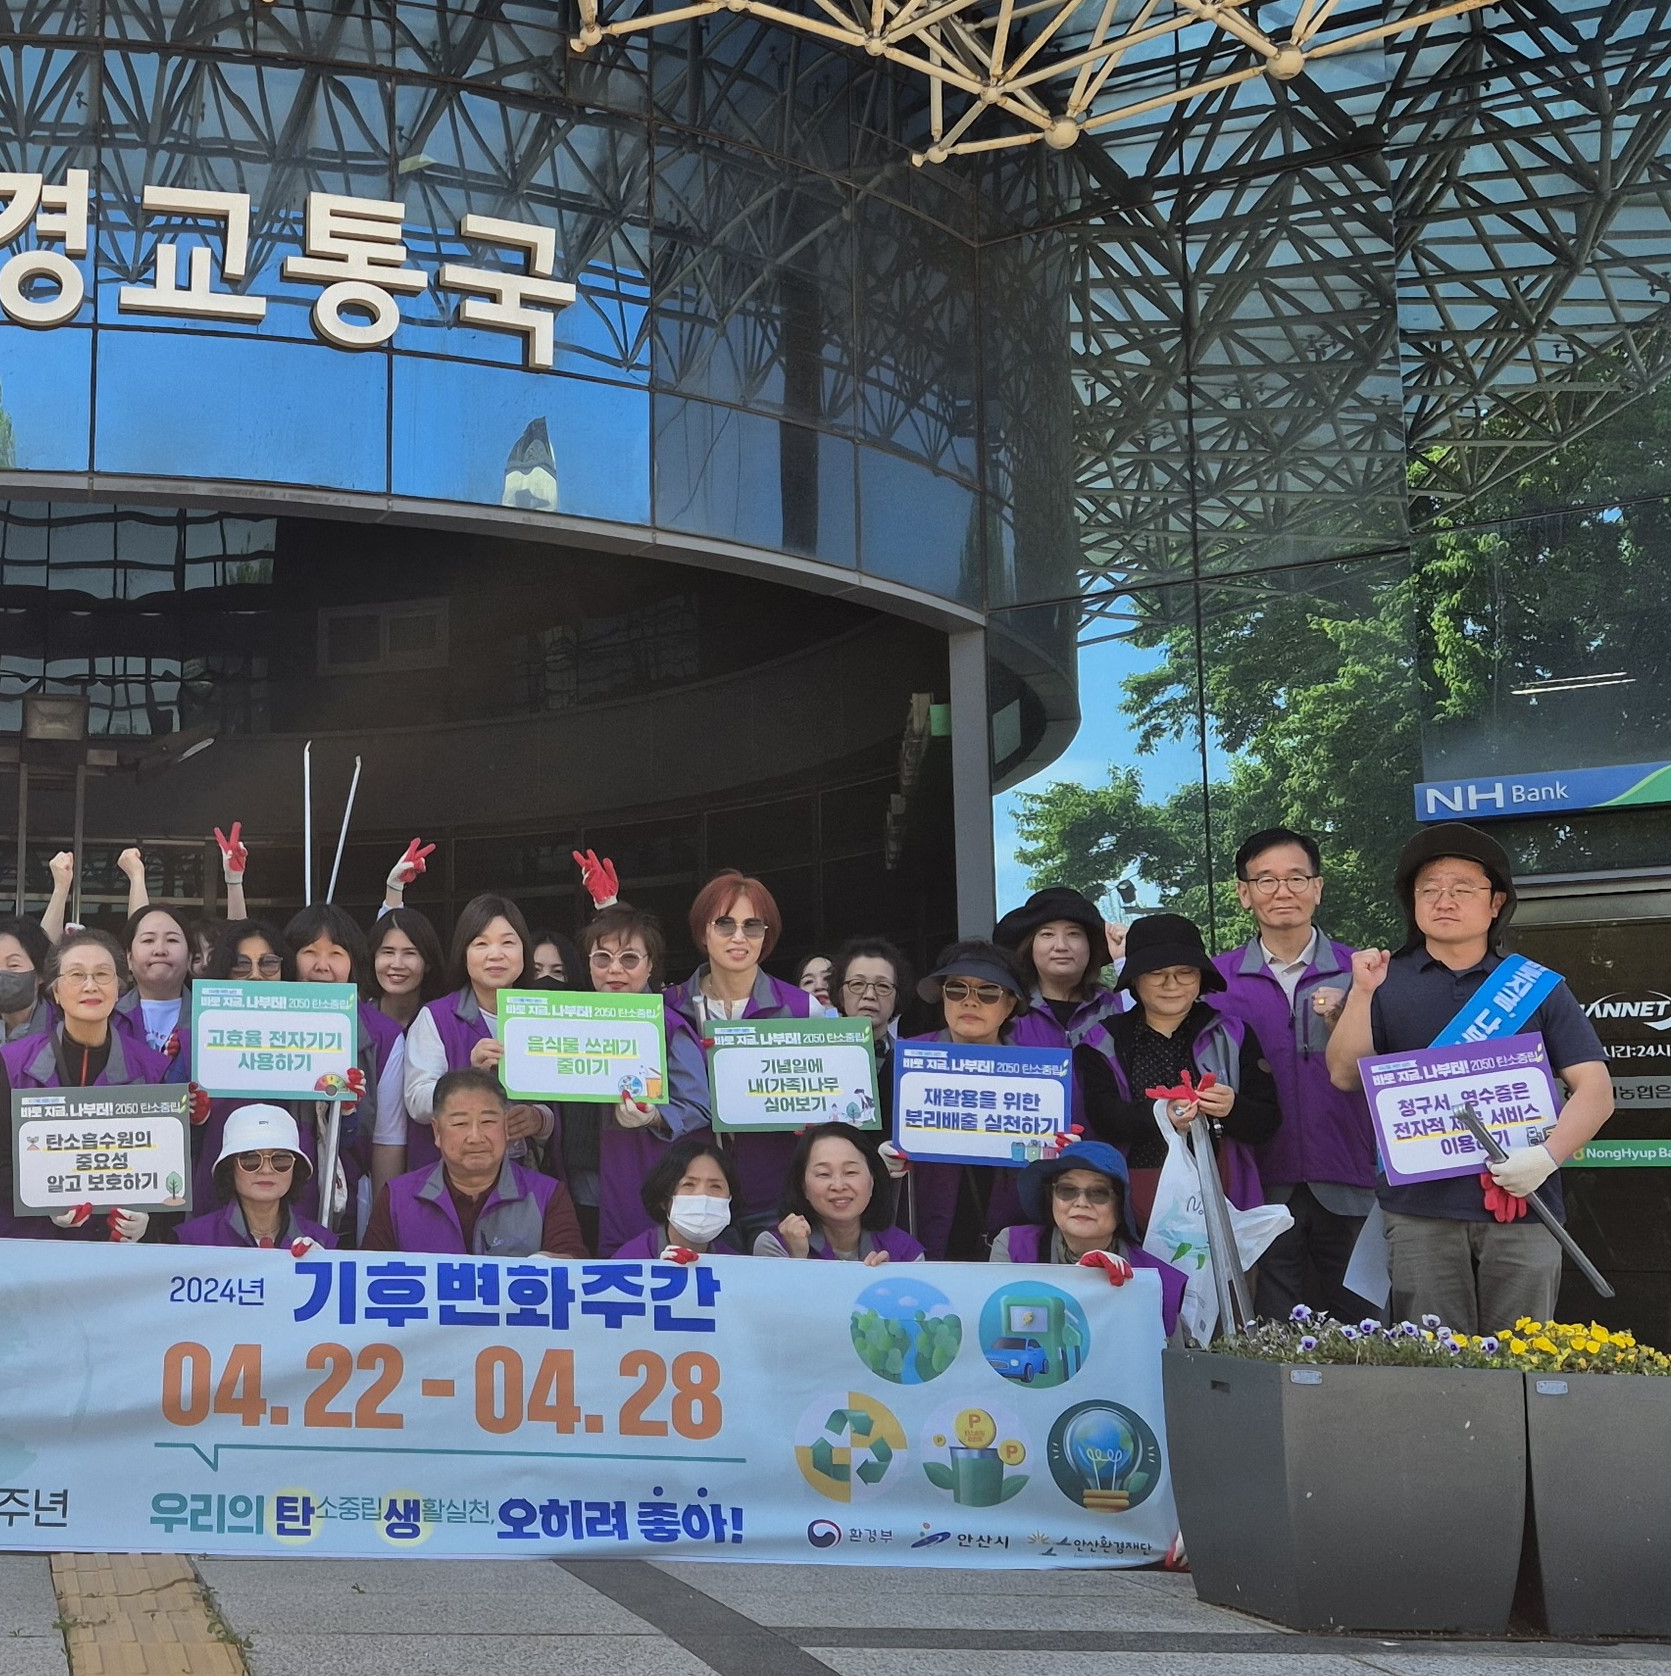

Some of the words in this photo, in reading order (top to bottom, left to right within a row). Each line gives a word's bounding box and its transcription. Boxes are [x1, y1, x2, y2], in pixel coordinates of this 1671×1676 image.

[1426, 782, 1504, 814] NH
[1512, 781, 1569, 803] Bank
[207, 1030, 262, 1048] 고효율
[269, 1030, 342, 1050] 전자기기
[528, 1036, 579, 1054] 음식물
[585, 1038, 637, 1056] 쓰레기
[803, 1033, 825, 1043] 2050
[238, 1052, 311, 1072] 사용하기
[557, 1058, 609, 1075] 줄이기
[761, 1058, 823, 1074] 기념일에
[996, 1062, 1019, 1073] 2050
[1471, 1058, 1496, 1072] 2050
[748, 1077, 839, 1094] 내(가족)나무
[1614, 1084, 1671, 1100] 농협은
[924, 1088, 997, 1109] 재활용을
[1003, 1092, 1041, 1112] 위한
[1461, 1082, 1530, 1107] 영수증은
[116, 1103, 139, 1114] 2050
[764, 1097, 827, 1112] 심어보기
[905, 1109, 978, 1130] 분리배출
[985, 1113, 1058, 1135] 실천하기
[1393, 1116, 1446, 1140] 전자적
[1491, 1104, 1542, 1125] 서비스
[45, 1131, 151, 1150] 탄소흡수원의
[76, 1153, 129, 1171] 중요성
[1586, 1147, 1657, 1161] NongHyup
[47, 1174, 82, 1193] 알고
[88, 1172, 158, 1192] 보호하기
[169, 1276, 264, 1307] 2024년
[293, 1261, 721, 1332] 기후변화주간
[968, 1413, 981, 1428] P
[1005, 1445, 1018, 1459] P
[150, 1493, 264, 1535] 우리의
[497, 1497, 629, 1541] 오히려
[638, 1498, 743, 1544] 좋아!
[848, 1527, 893, 1543] 환경부
[956, 1533, 1010, 1549] 안산시
[1073, 1535, 1153, 1556] 안산환경재단
